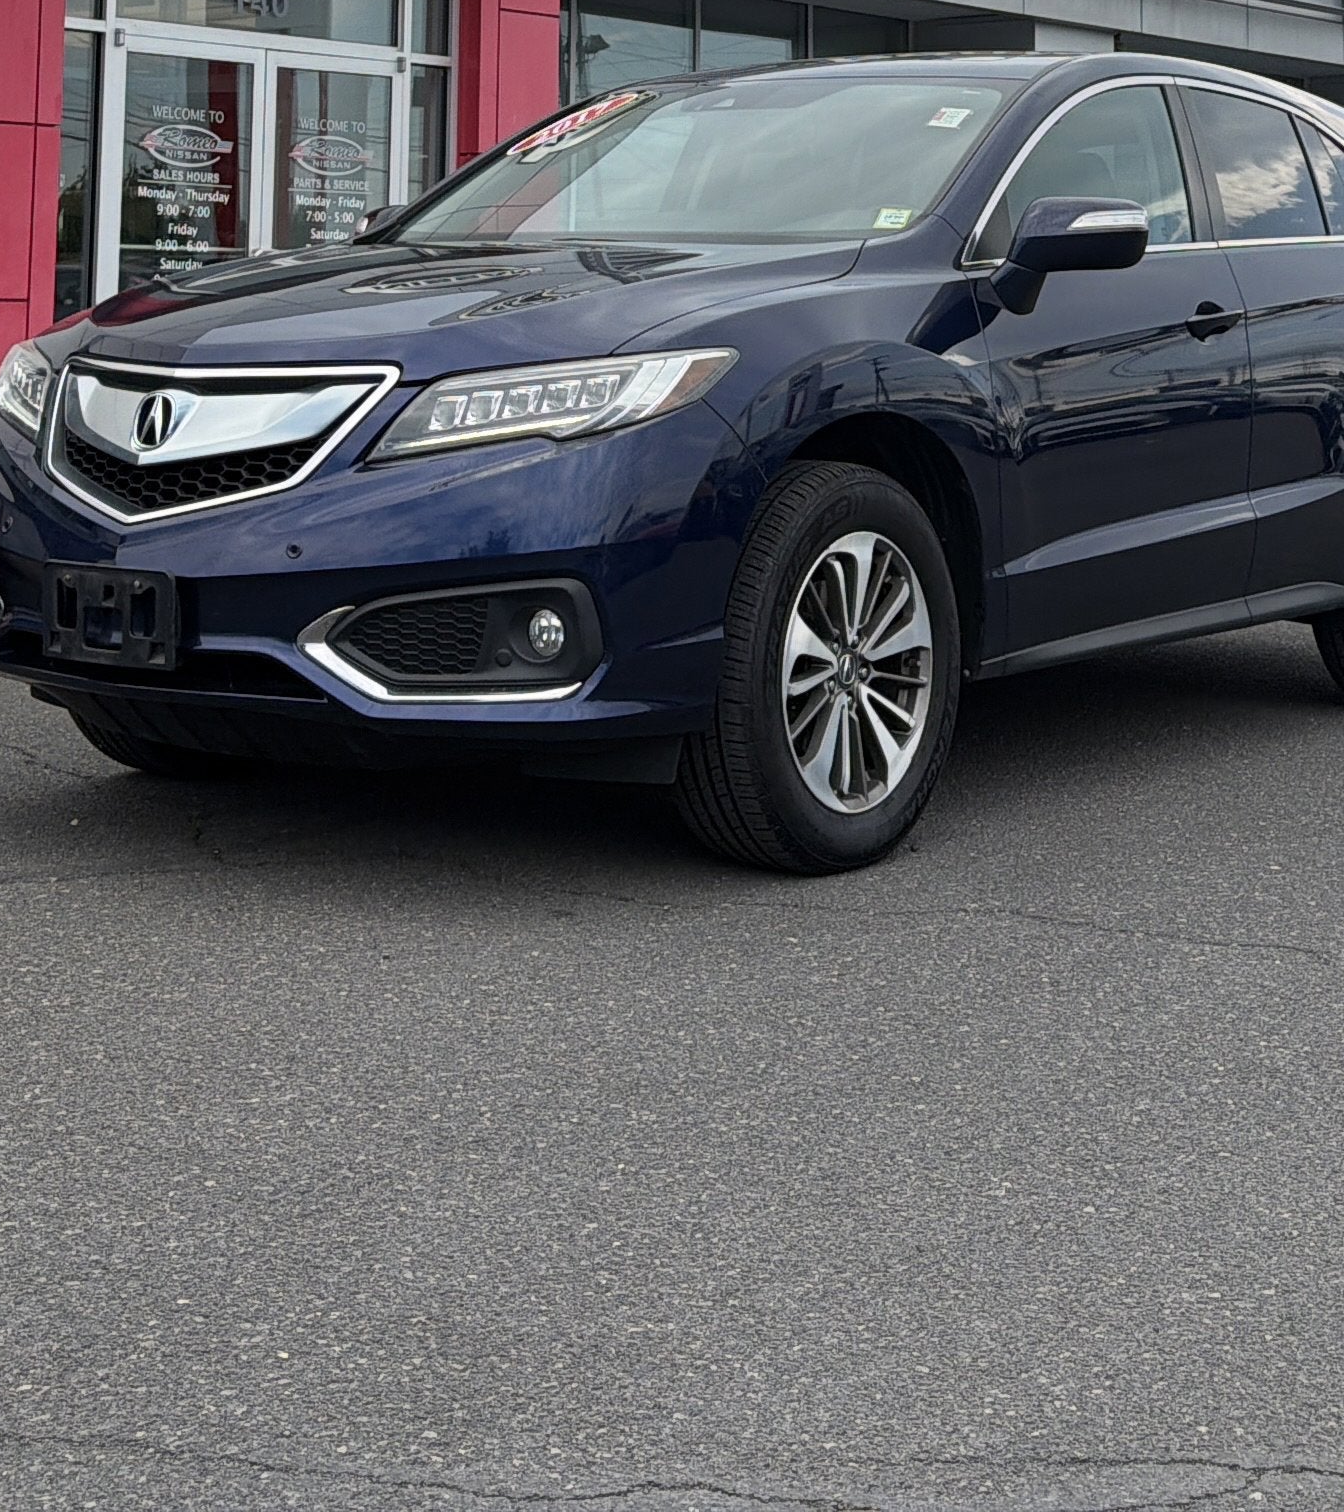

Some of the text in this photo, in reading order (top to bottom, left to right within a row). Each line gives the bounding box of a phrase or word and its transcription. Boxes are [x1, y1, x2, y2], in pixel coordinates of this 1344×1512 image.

[152, 105, 225, 124] WELCOME TO
[298, 117, 366, 135] WELCOME TO
[159, 127, 218, 152] Romeo
[165, 150, 208, 161] NISSAN
[312, 160, 351, 169] NISSAN
[152, 169, 220, 184] SALES HOURS
[293, 176, 369, 192] PARTS & SERVICE
[137, 185, 178, 201] Monday
[185, 188, 231, 206] Thursday
[295, 194, 331, 208] Monday
[338, 196, 365, 210] Friday
[156, 204, 180, 217] 9:00
[188, 205, 211, 218] 7:00
[306, 211, 327, 223] 7:00
[334, 211, 355, 224] 5:00
[168, 222, 199, 238] Friday
[155, 239, 178, 251] 9:00
[186, 240, 209, 253] 6:00
